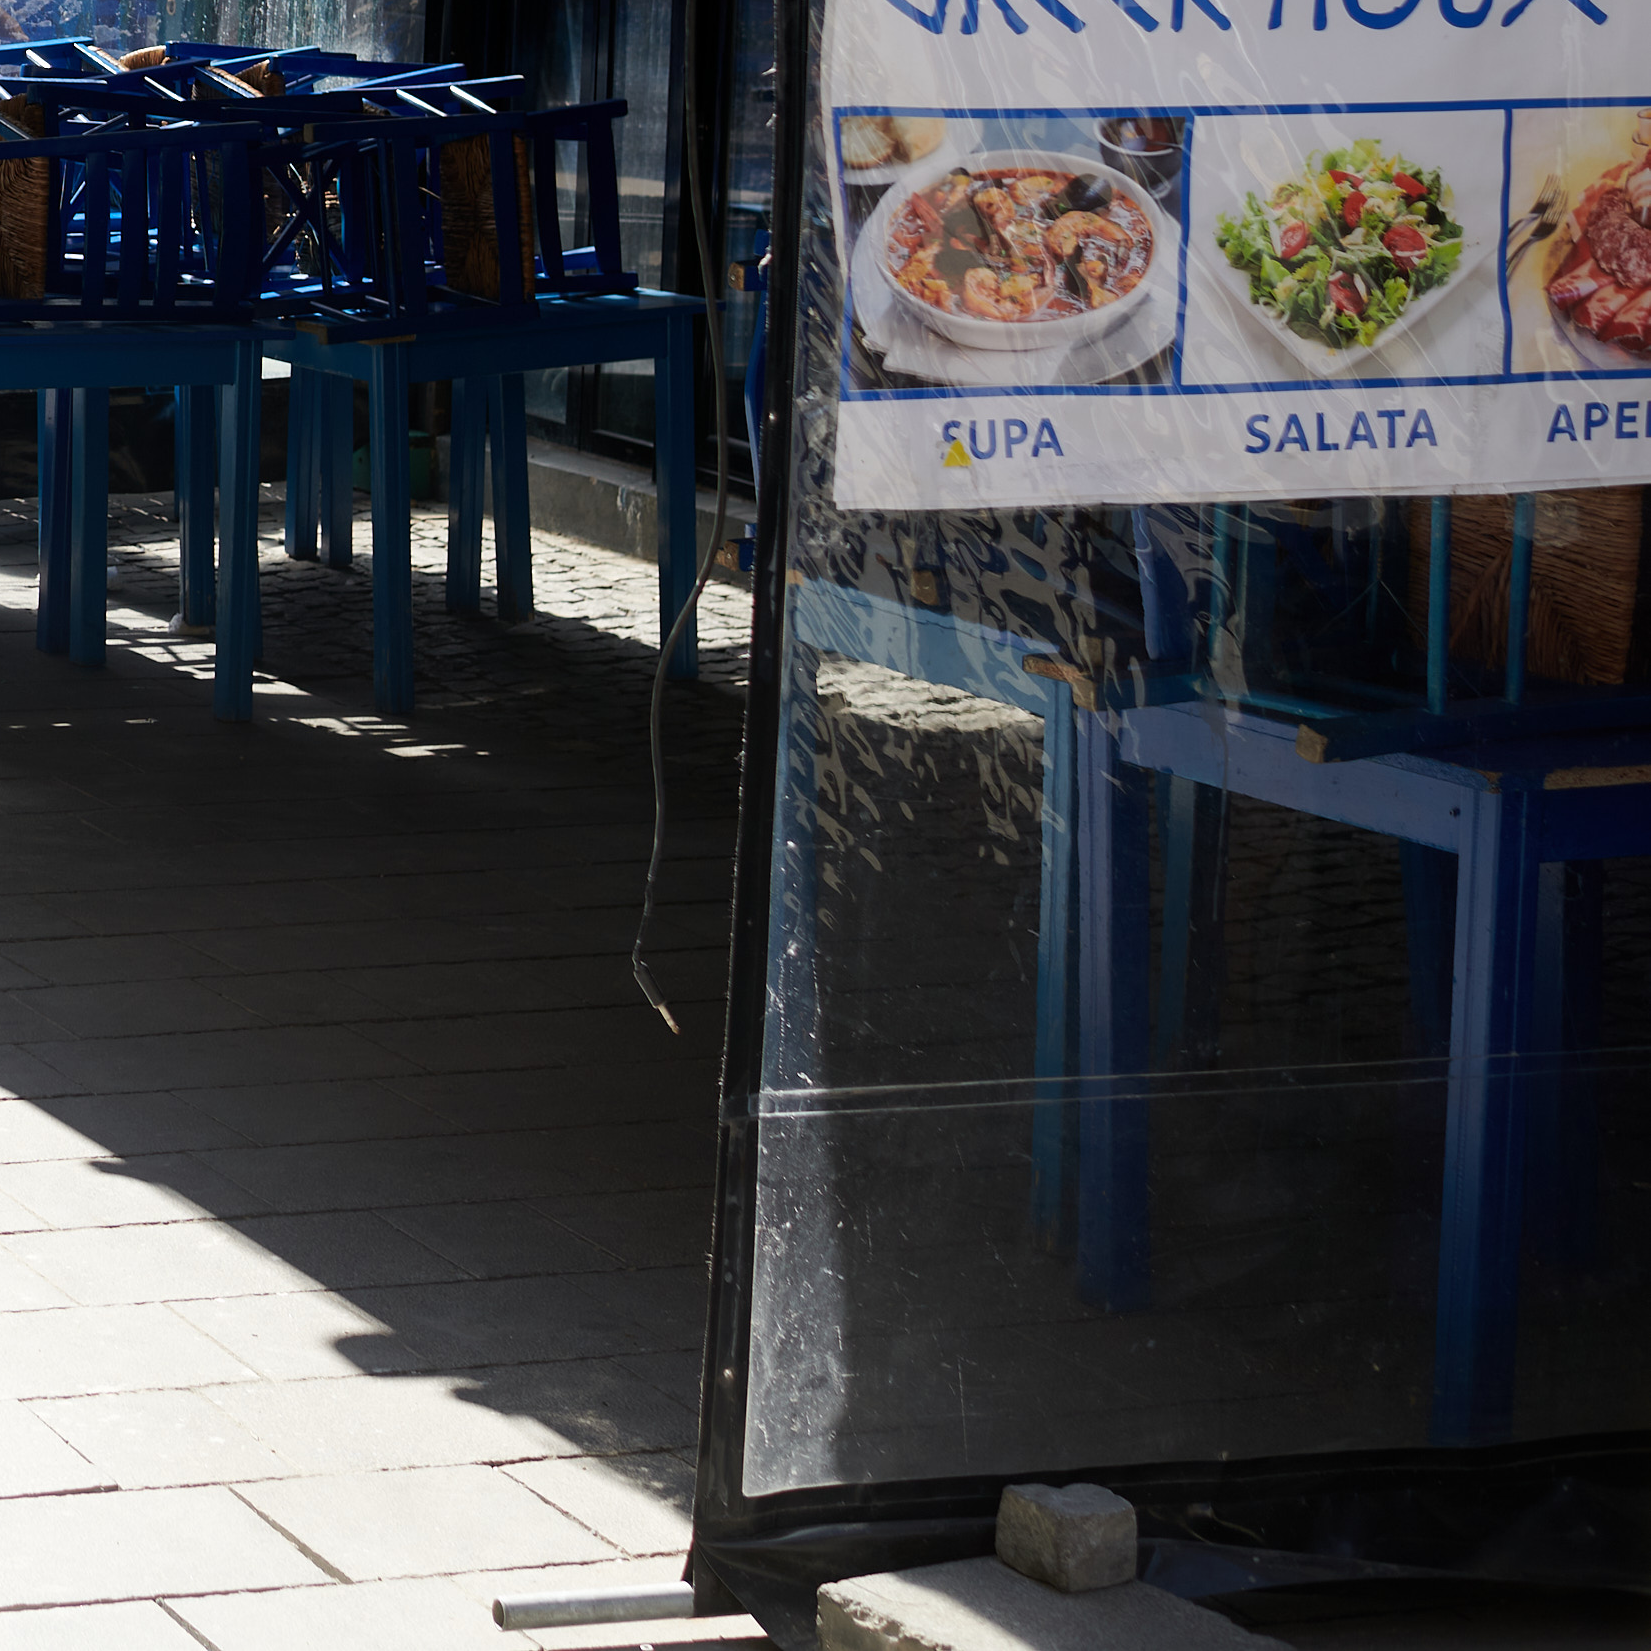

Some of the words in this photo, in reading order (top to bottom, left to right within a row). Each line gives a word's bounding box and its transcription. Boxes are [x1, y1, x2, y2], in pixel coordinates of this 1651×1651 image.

[942, 416, 1065, 462] SUPA
[1244, 407, 1439, 455] SALATA
[1547, 401, 1651, 444] APE
